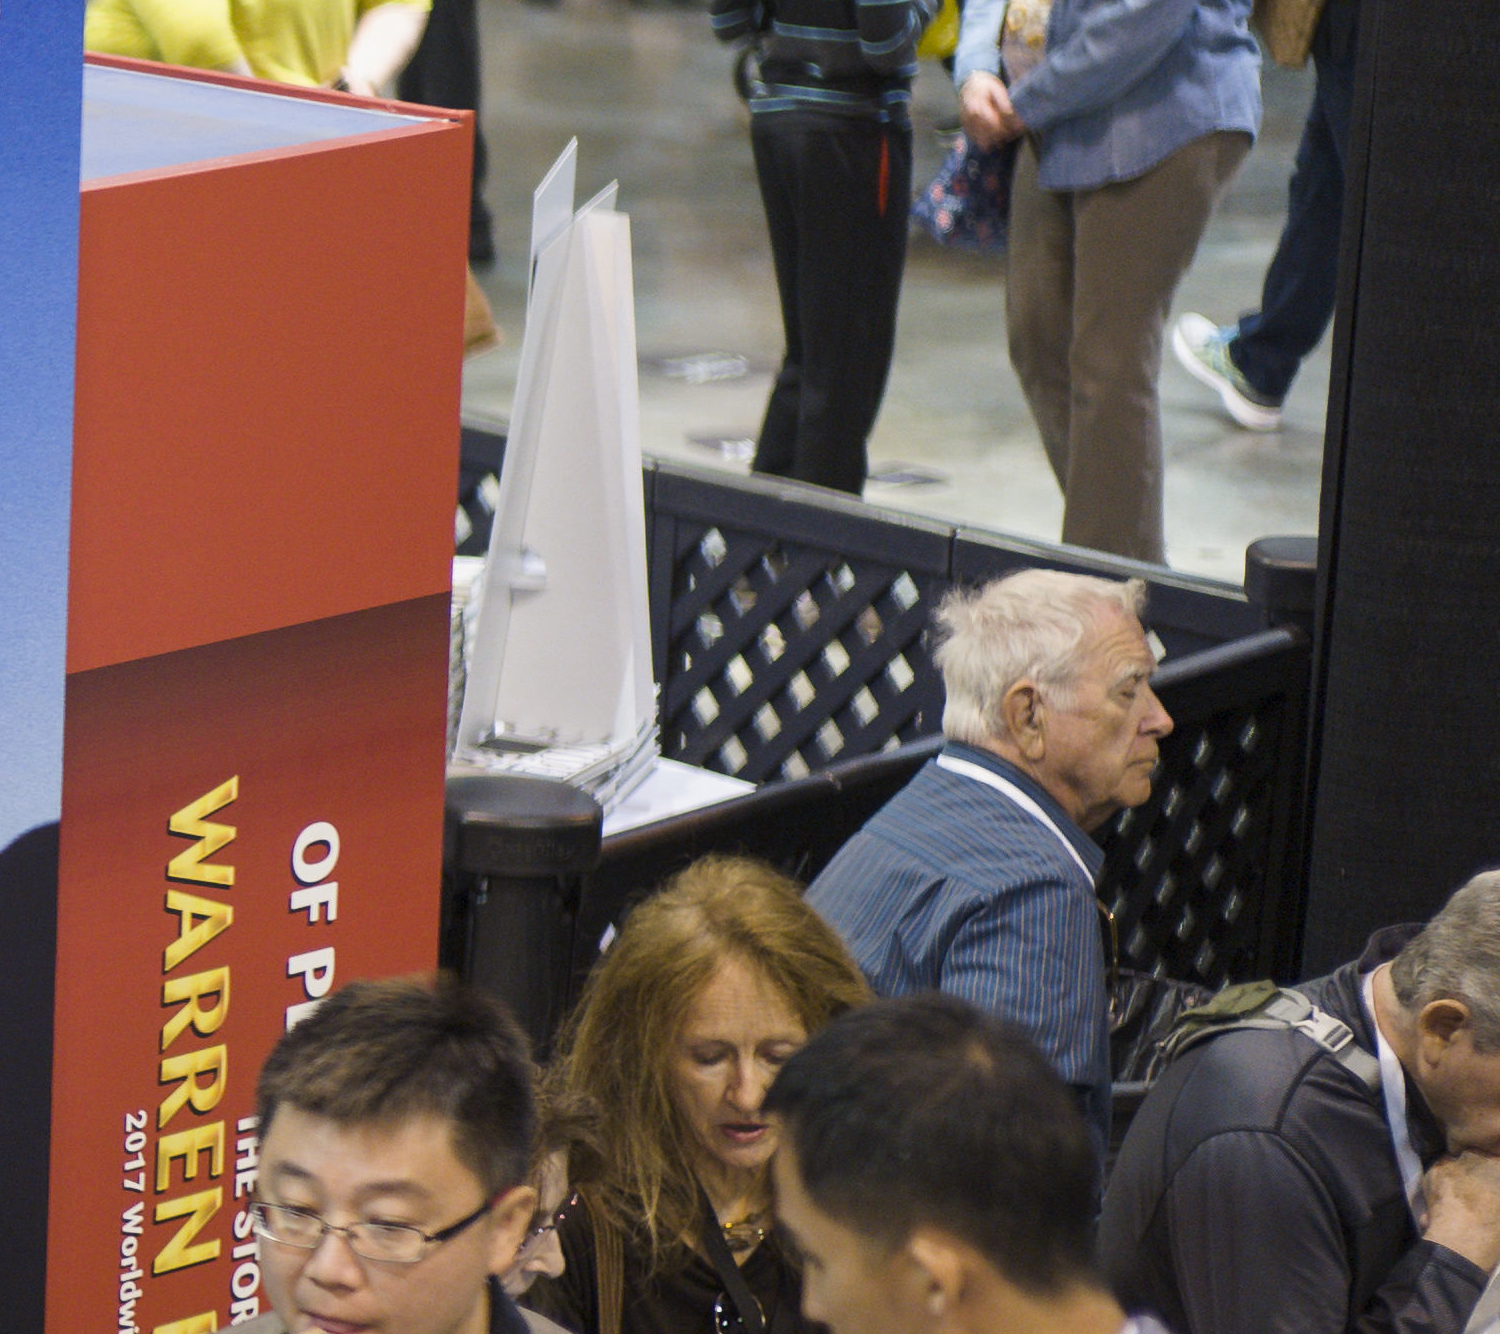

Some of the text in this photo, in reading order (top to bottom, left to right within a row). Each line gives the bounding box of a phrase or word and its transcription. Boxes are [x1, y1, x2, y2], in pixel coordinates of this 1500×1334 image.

[290, 820, 341, 923] OF
[153, 774, 240, 1276] WARREN
[122, 1109, 149, 1193] 2017
[230, 1209, 264, 1327] STOR
